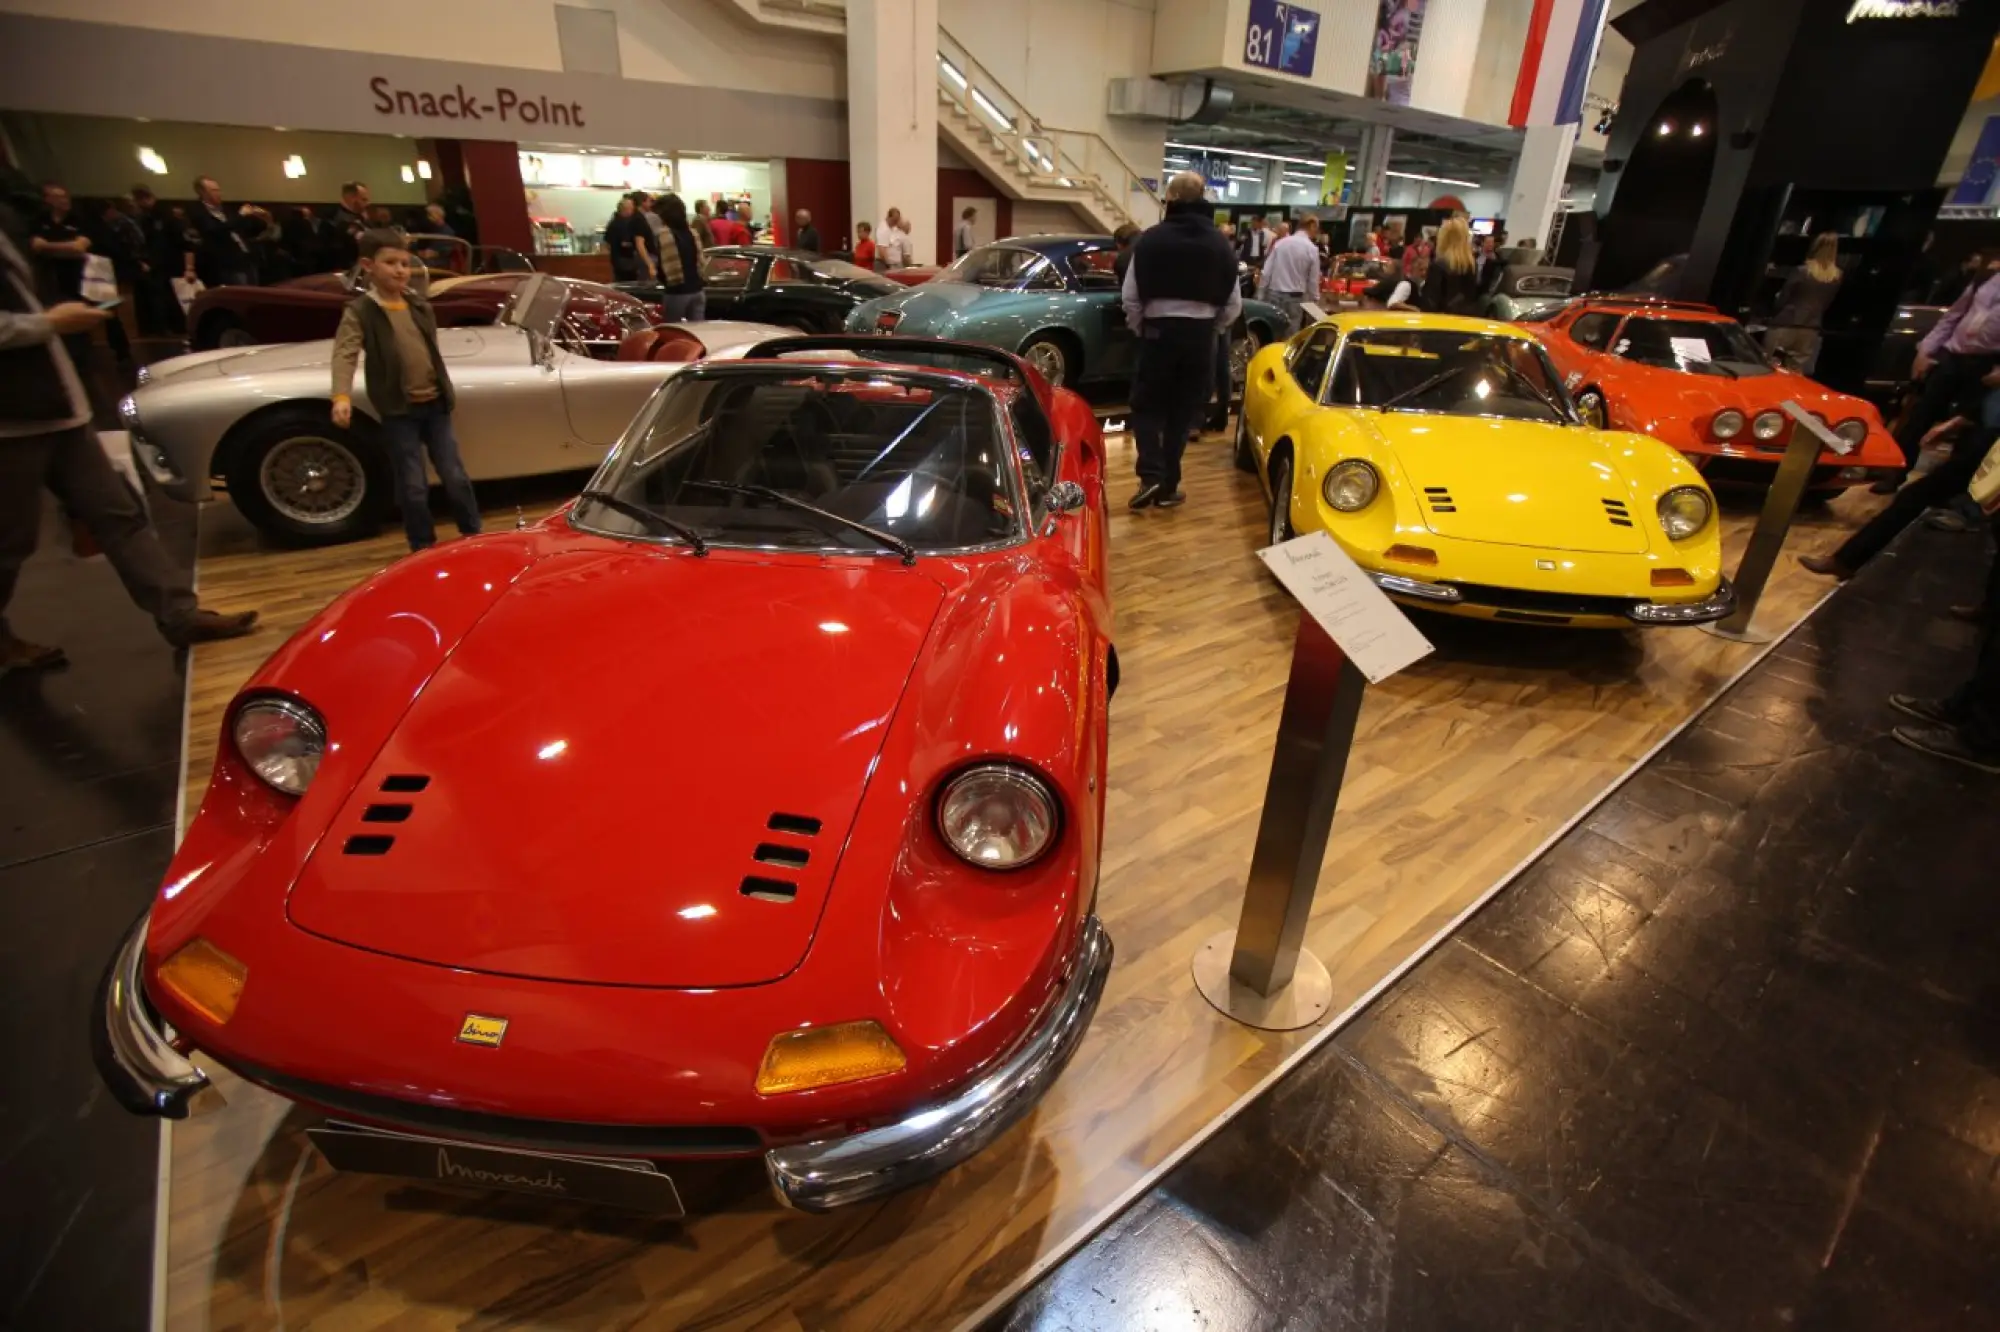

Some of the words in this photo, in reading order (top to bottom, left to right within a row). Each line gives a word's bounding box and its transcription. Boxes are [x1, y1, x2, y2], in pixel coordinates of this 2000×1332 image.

[1246, 24, 1273, 64] 8.1
[369, 76, 586, 127] Snack-Point
[463, 1022, 498, 1037] Dino
[437, 1147, 567, 1191] Movendi
